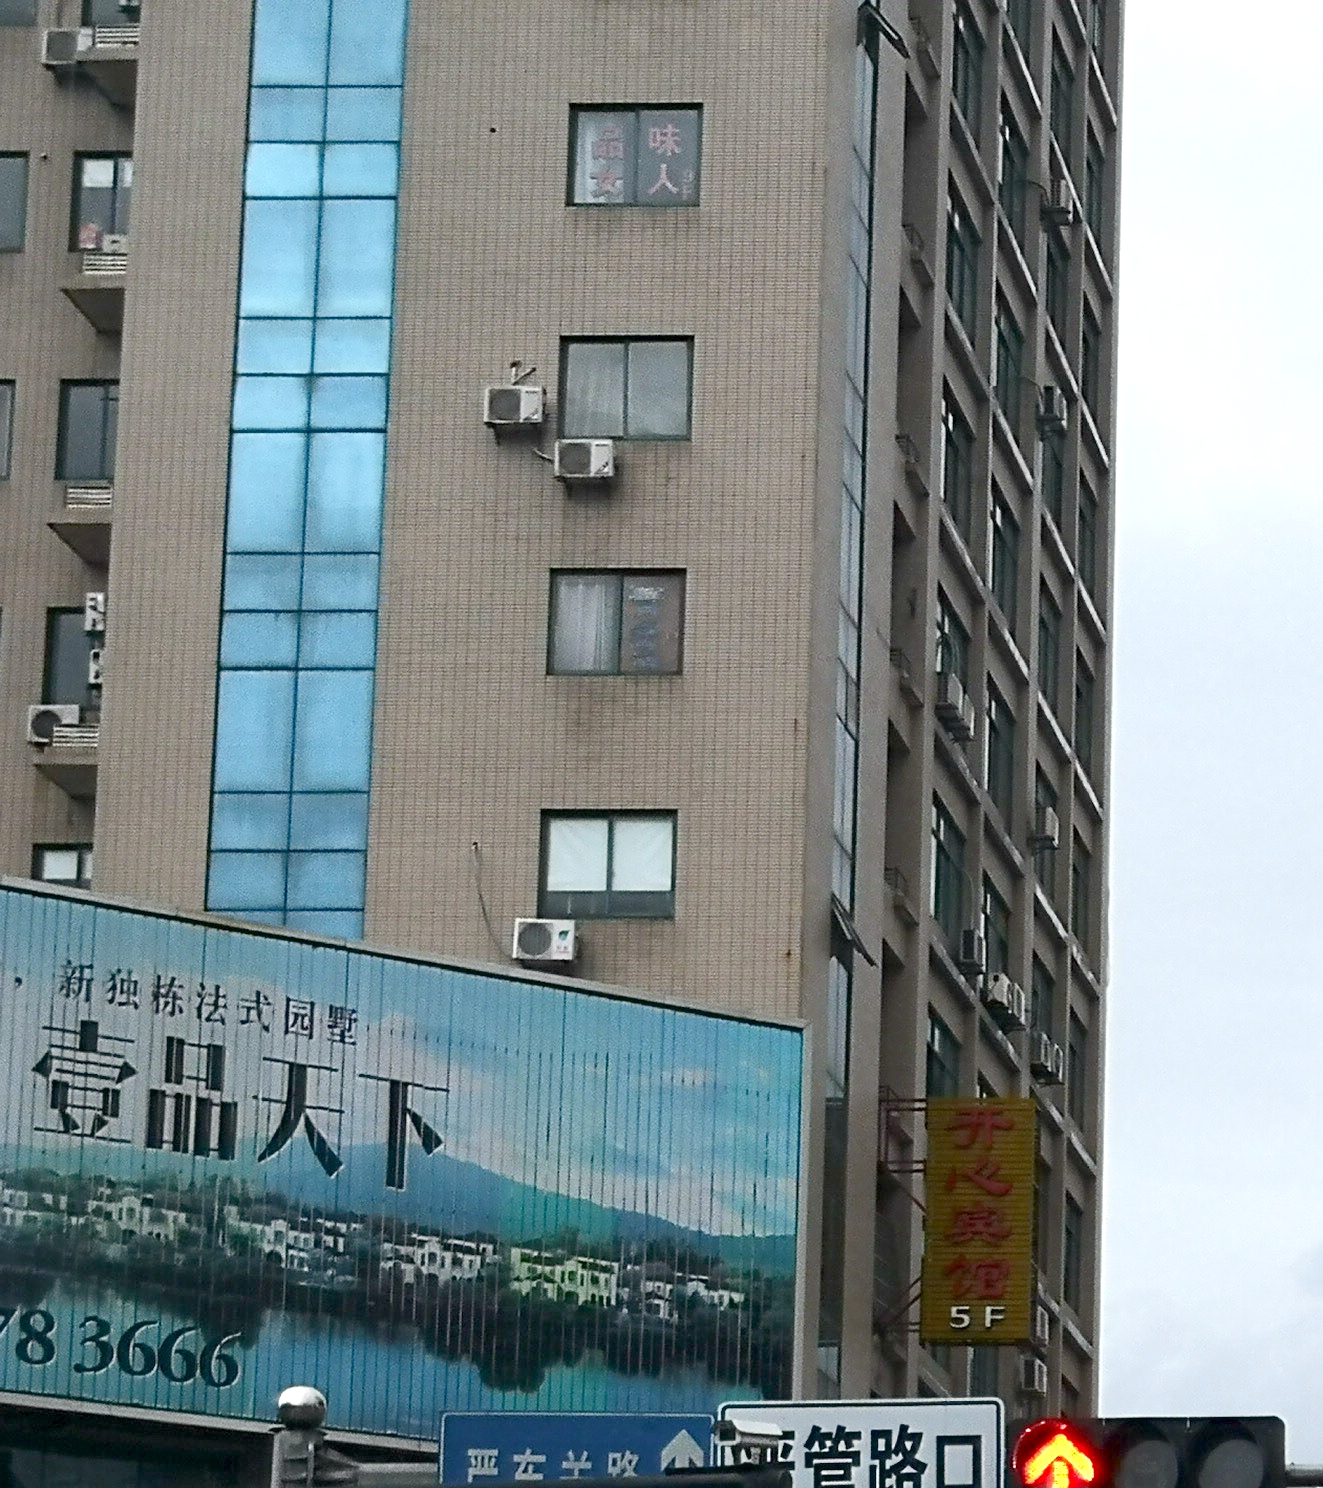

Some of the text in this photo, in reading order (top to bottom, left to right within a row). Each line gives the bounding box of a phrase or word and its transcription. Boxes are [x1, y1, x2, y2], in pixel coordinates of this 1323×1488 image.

[58, 959, 360, 1047] 新独栋法式园墅
[32, 1019, 450, 1192] 壹品天下
